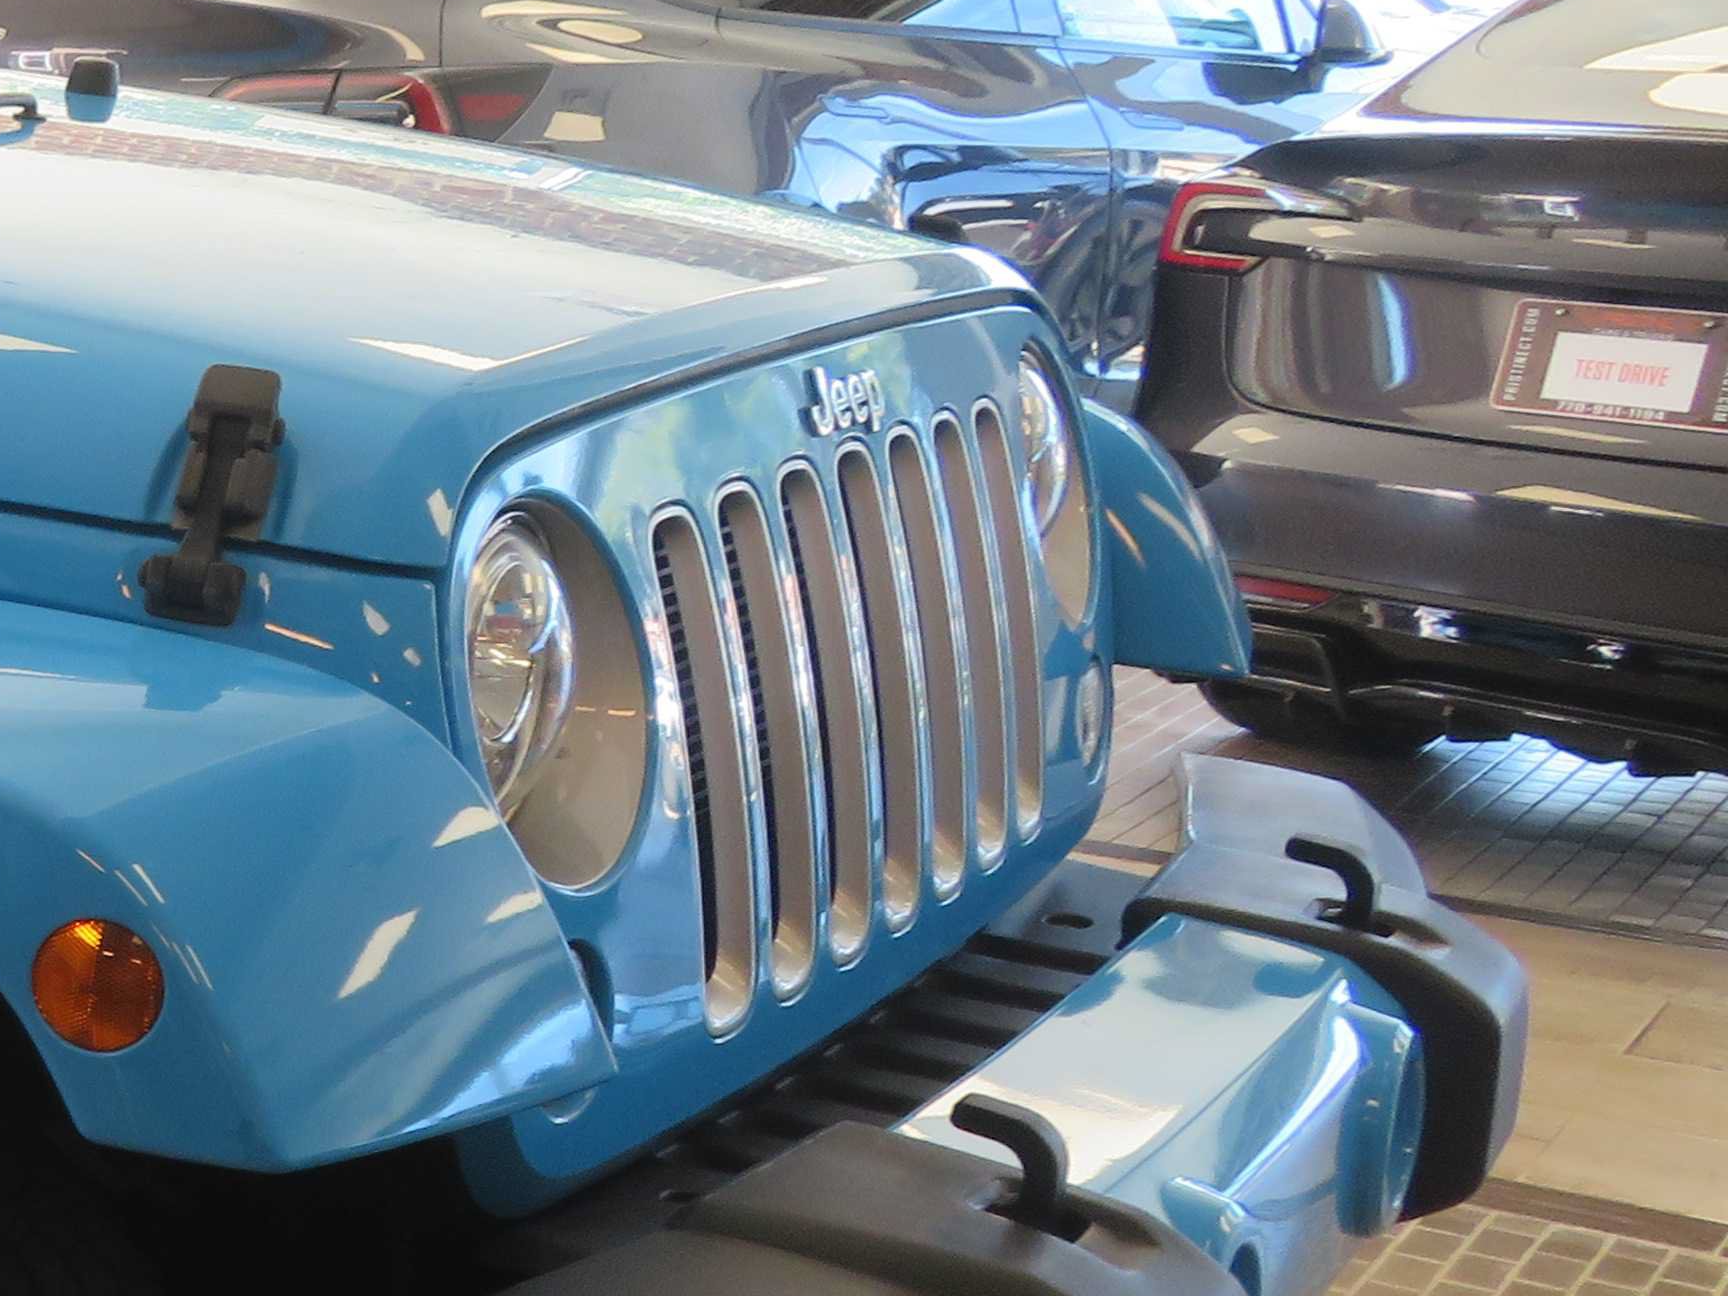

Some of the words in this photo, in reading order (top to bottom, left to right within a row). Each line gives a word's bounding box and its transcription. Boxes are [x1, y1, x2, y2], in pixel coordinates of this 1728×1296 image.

[1575, 359, 1616, 381] TEST
[1618, 361, 1673, 387] DRIVE
[799, 366, 885, 437] Jeep
